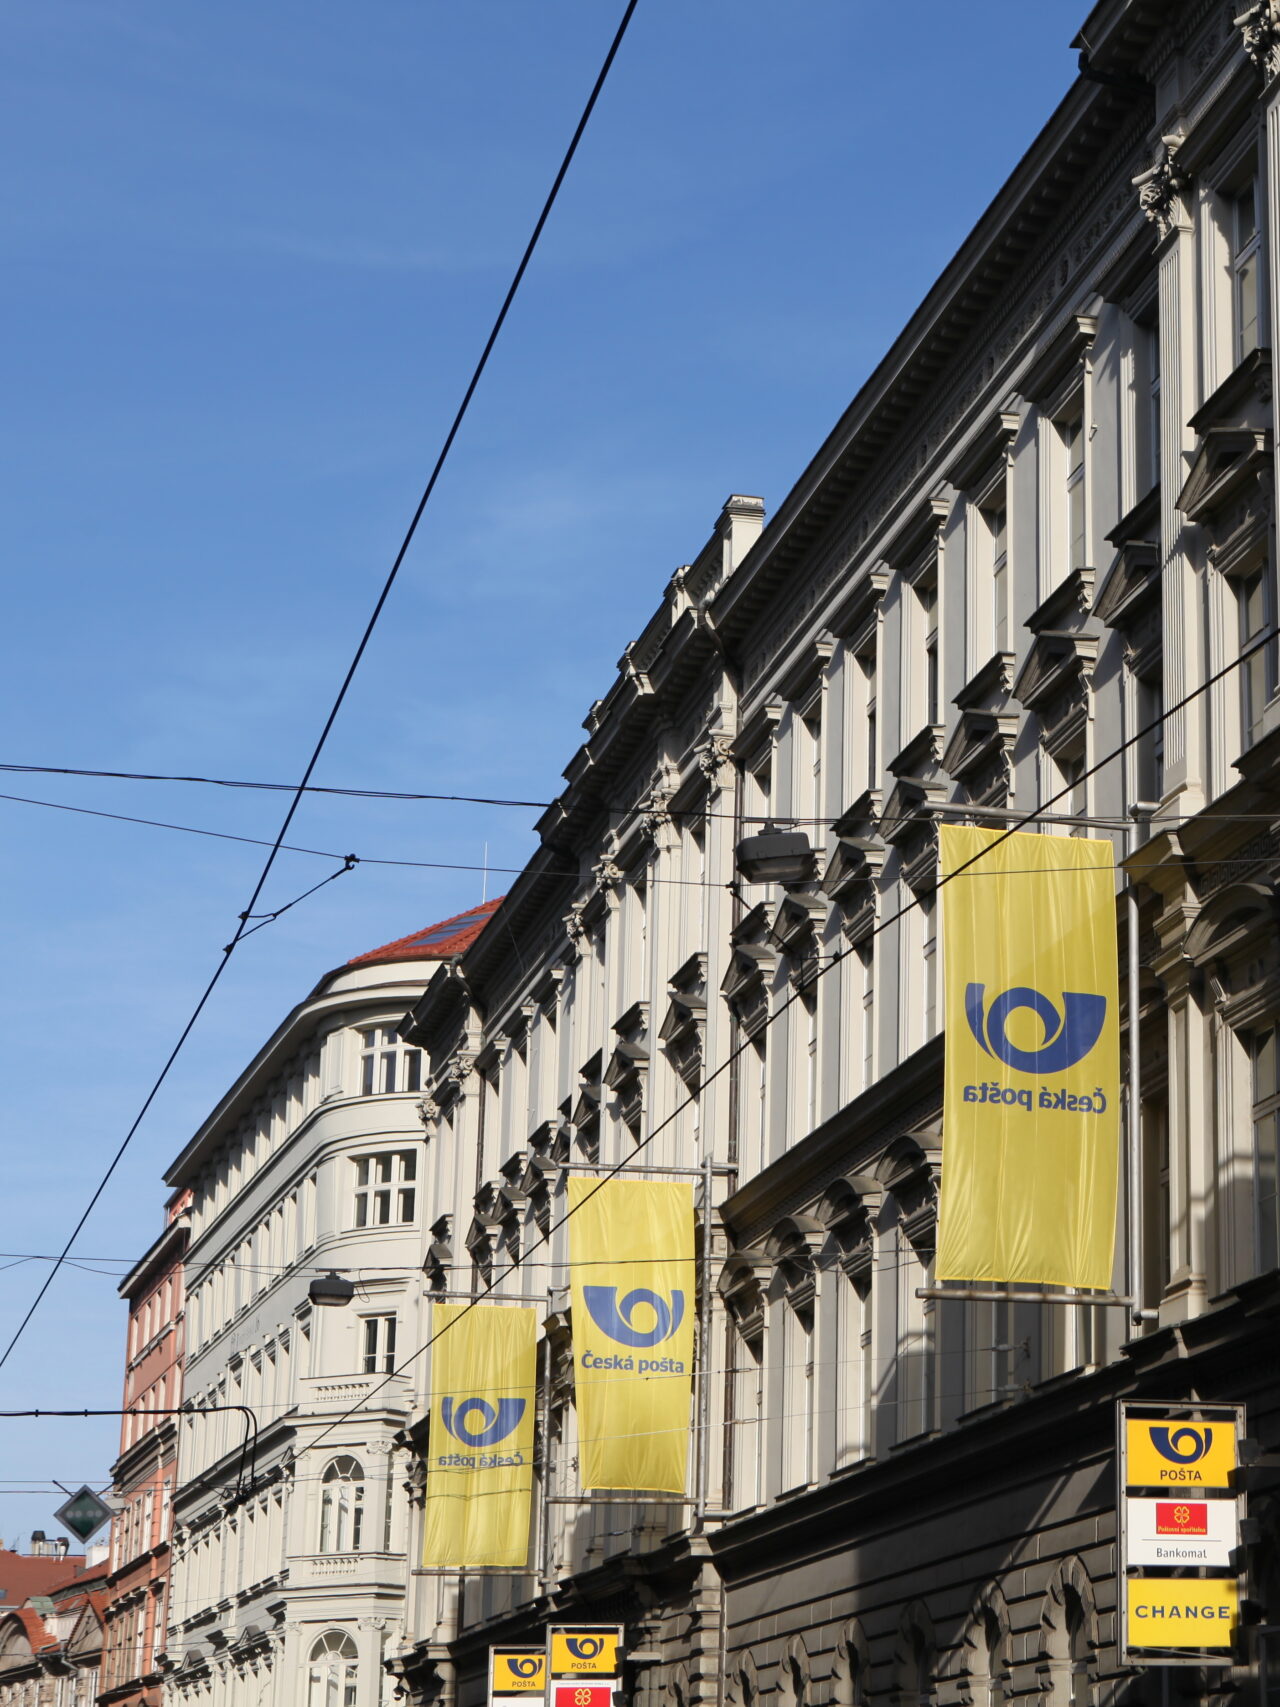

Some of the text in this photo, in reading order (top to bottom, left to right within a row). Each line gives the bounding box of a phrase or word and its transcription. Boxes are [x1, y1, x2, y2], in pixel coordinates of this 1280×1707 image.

[581, 1350, 685, 1374] Česká pošta
[1160, 1467, 1203, 1481] POŠTA
[1156, 1547, 1207, 1559] Bankomat
[1135, 1605, 1231, 1619] CHANGE
[571, 1661, 597, 1670] POŠTA
[511, 1679, 536, 1688] POŠTA
